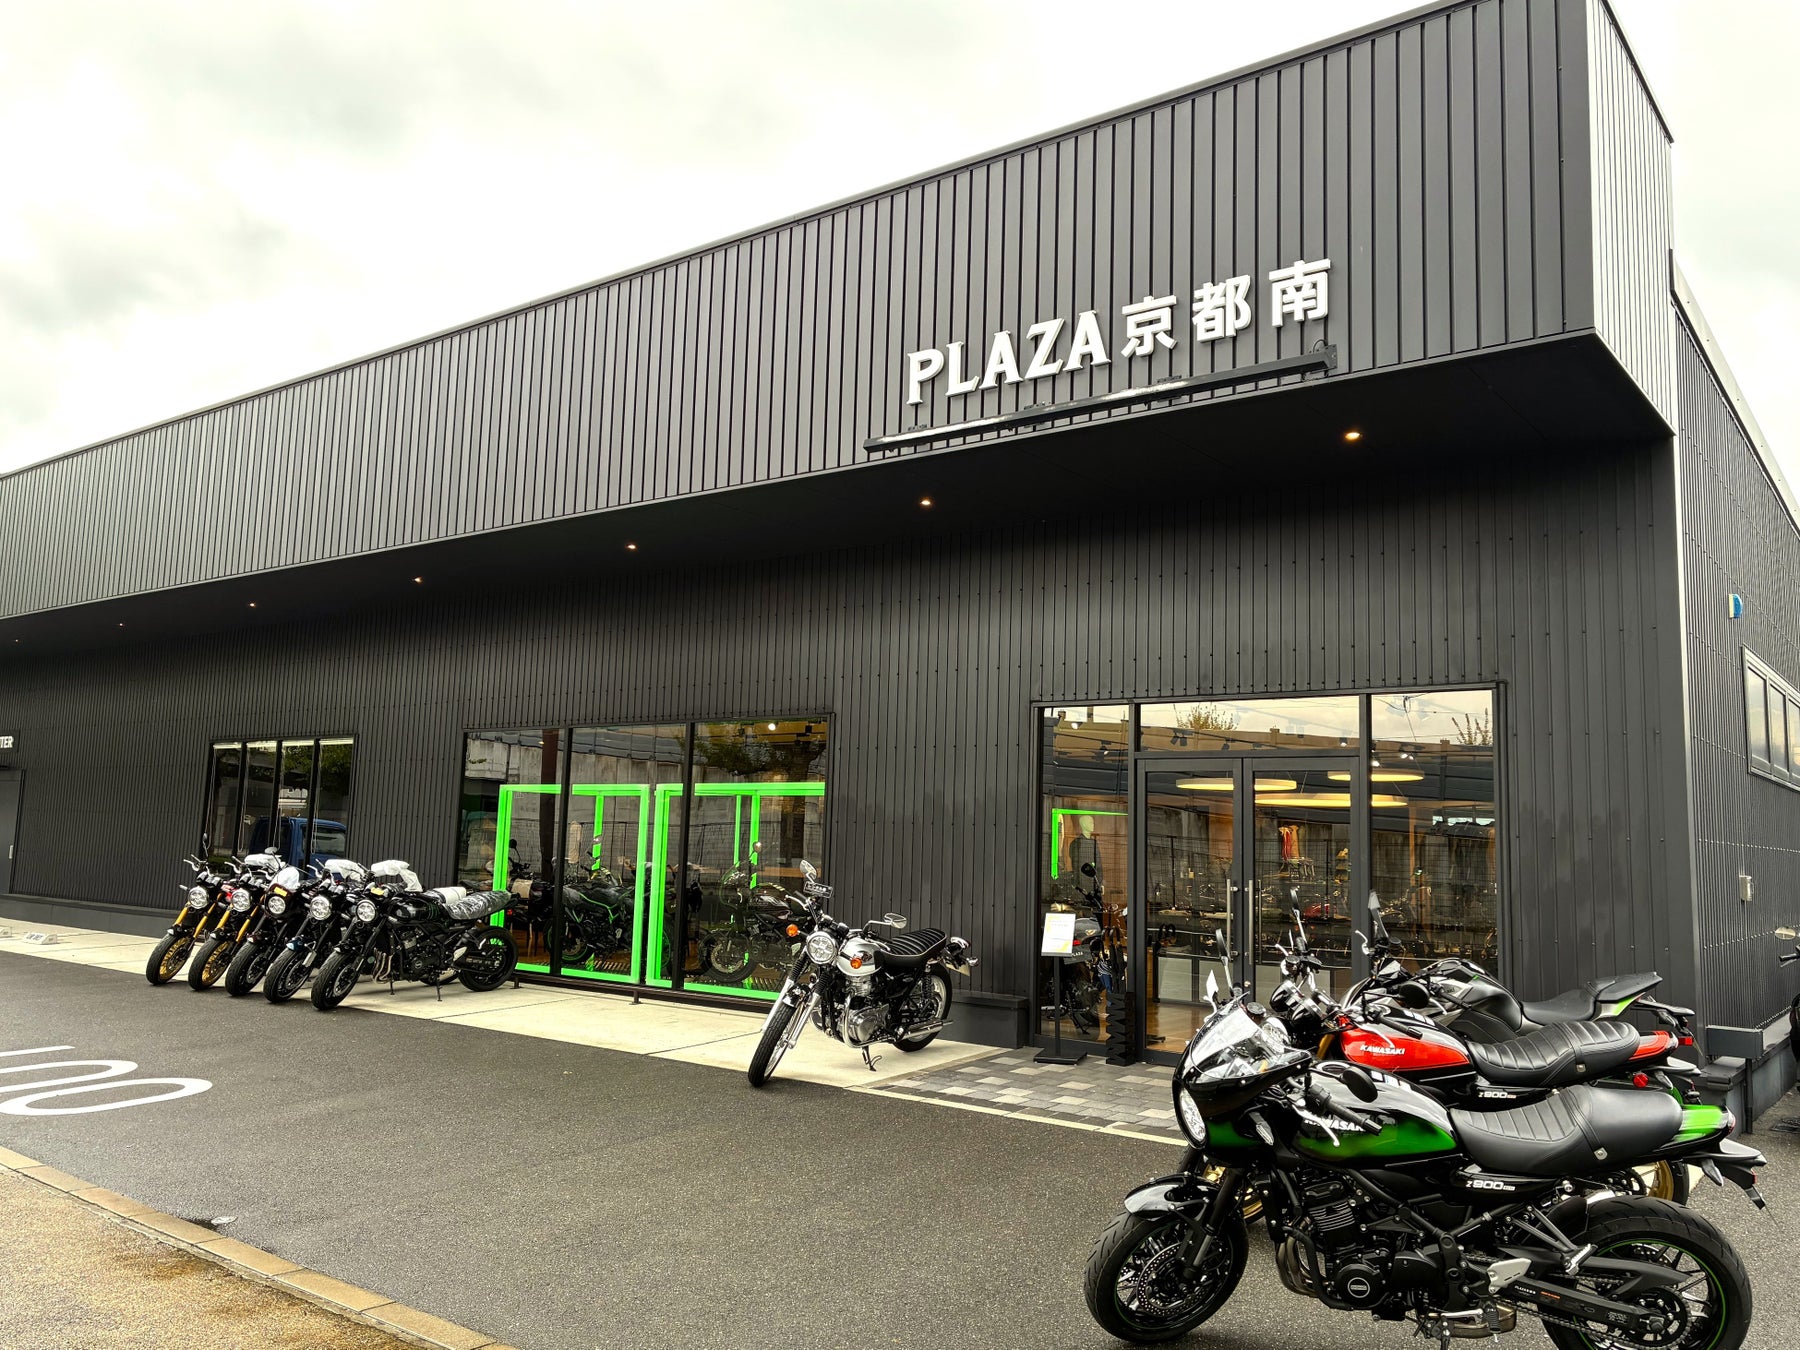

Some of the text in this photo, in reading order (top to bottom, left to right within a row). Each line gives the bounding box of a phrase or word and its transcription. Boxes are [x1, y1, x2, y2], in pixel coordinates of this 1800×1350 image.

[906, 258, 1332, 405] PLAZA 京都南
[1360, 1044, 1406, 1056] KAWASAKI
